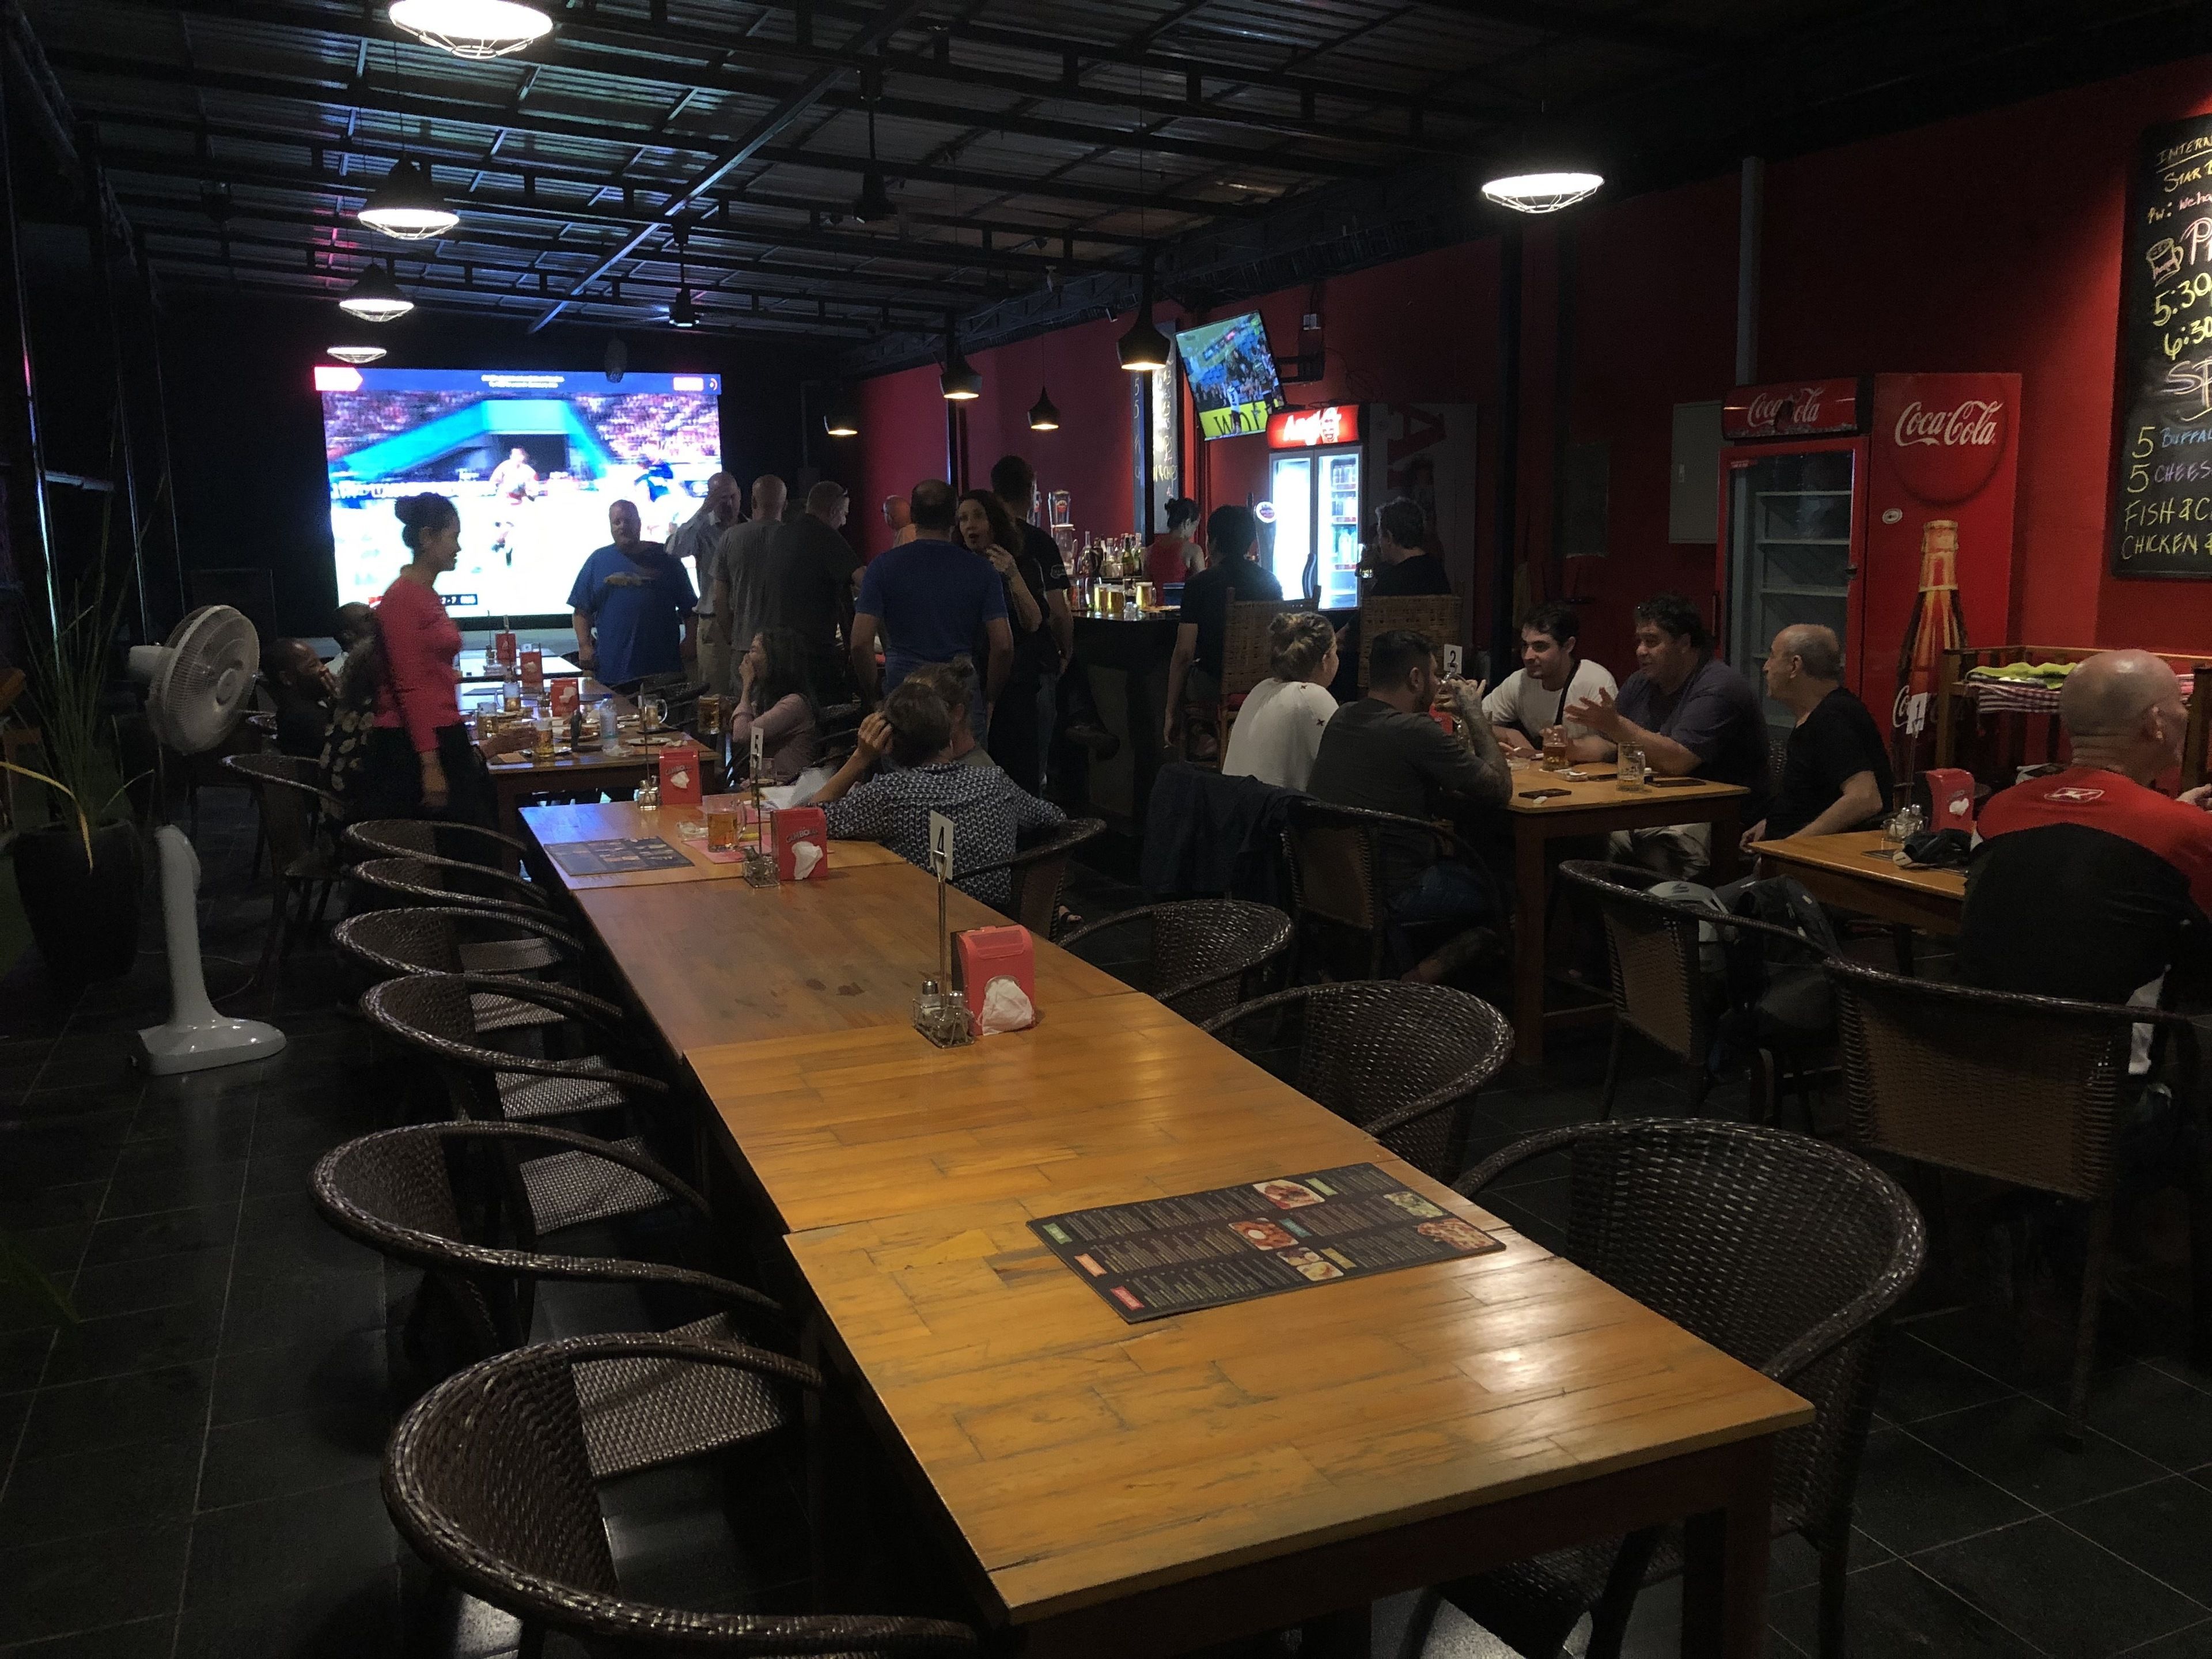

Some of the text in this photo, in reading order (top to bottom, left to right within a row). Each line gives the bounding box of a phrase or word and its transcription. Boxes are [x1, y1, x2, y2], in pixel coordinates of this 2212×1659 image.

[1895, 400, 2003, 446] Coca-Cola
[2132, 426, 2156, 459] 5
[2127, 463, 2150, 493] 5
[2124, 497, 2176, 532] FISH
[2121, 532, 2198, 559] CHICKEN
[1450, 650, 1456, 668] 2
[937, 825, 945, 863] 4
